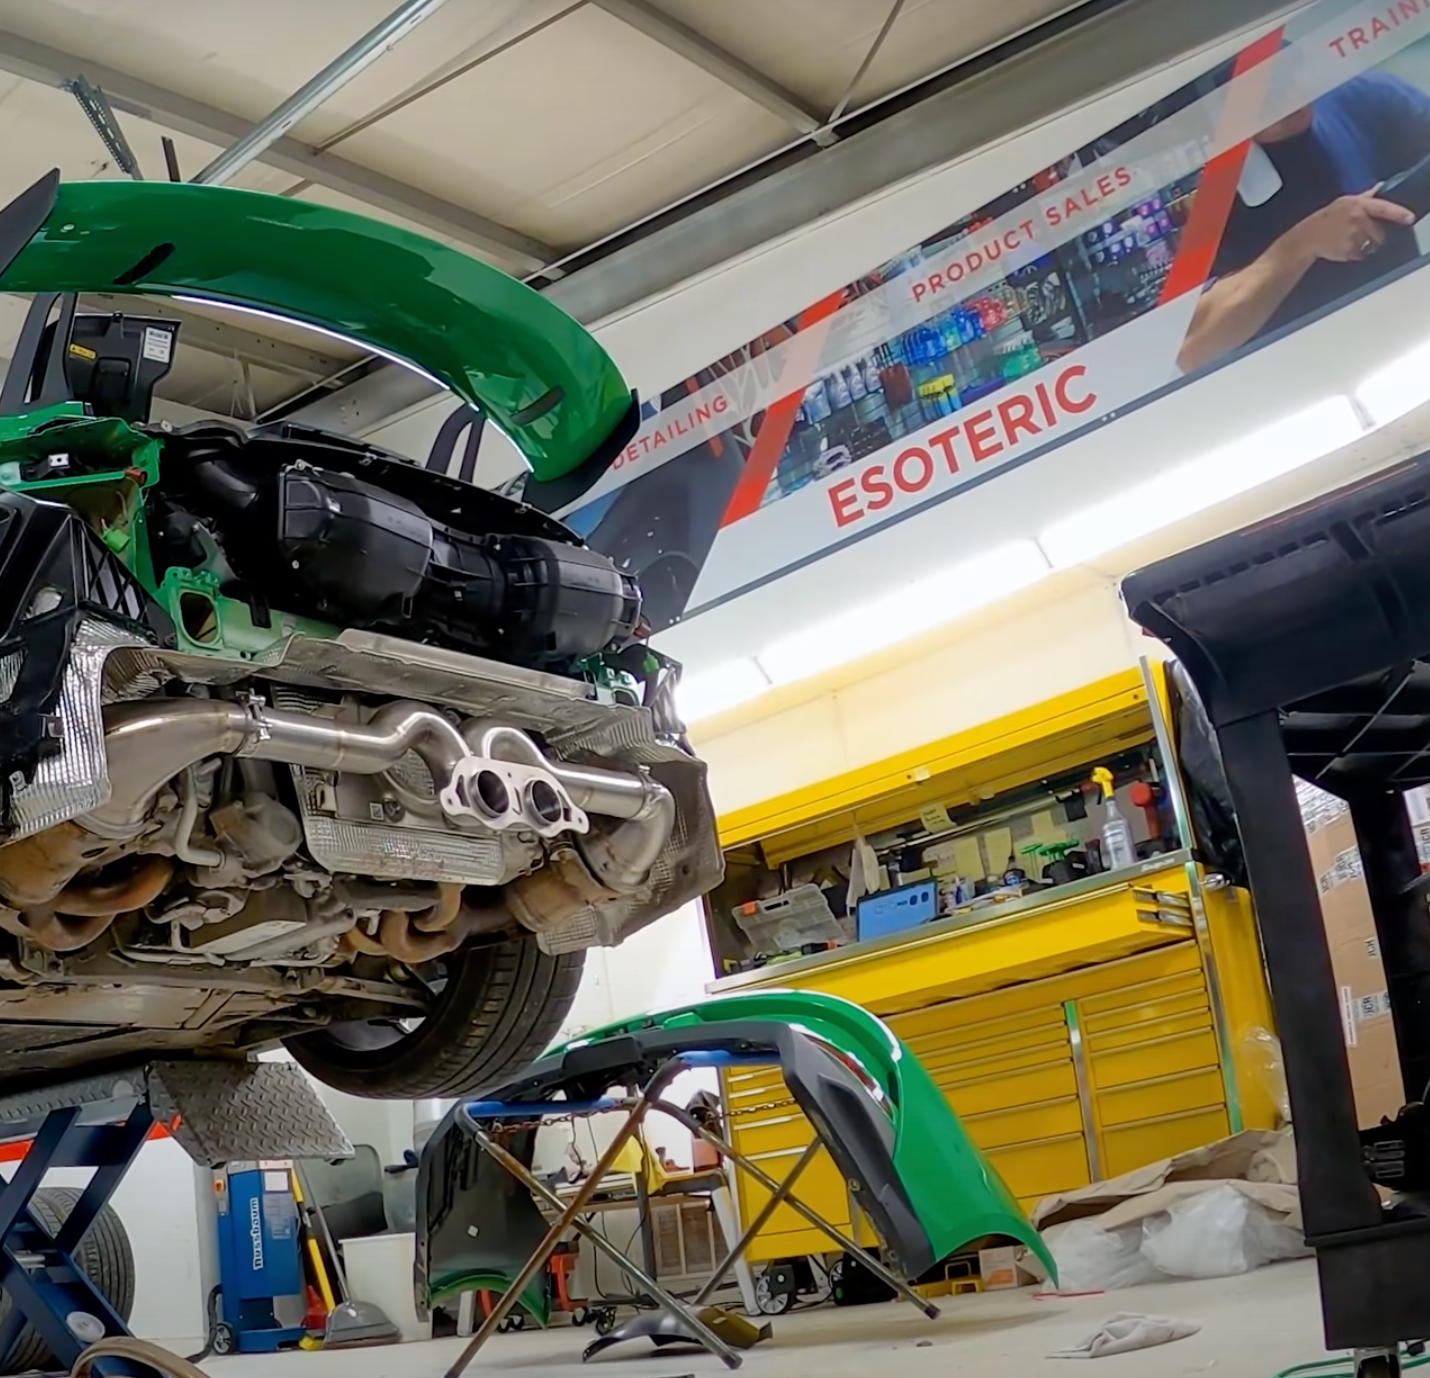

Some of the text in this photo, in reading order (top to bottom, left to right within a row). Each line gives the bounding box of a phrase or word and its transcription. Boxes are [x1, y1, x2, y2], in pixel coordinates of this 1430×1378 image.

[911, 166, 1132, 303] PRODUCT SALES
[827, 365, 1098, 529] ESOTERIC
